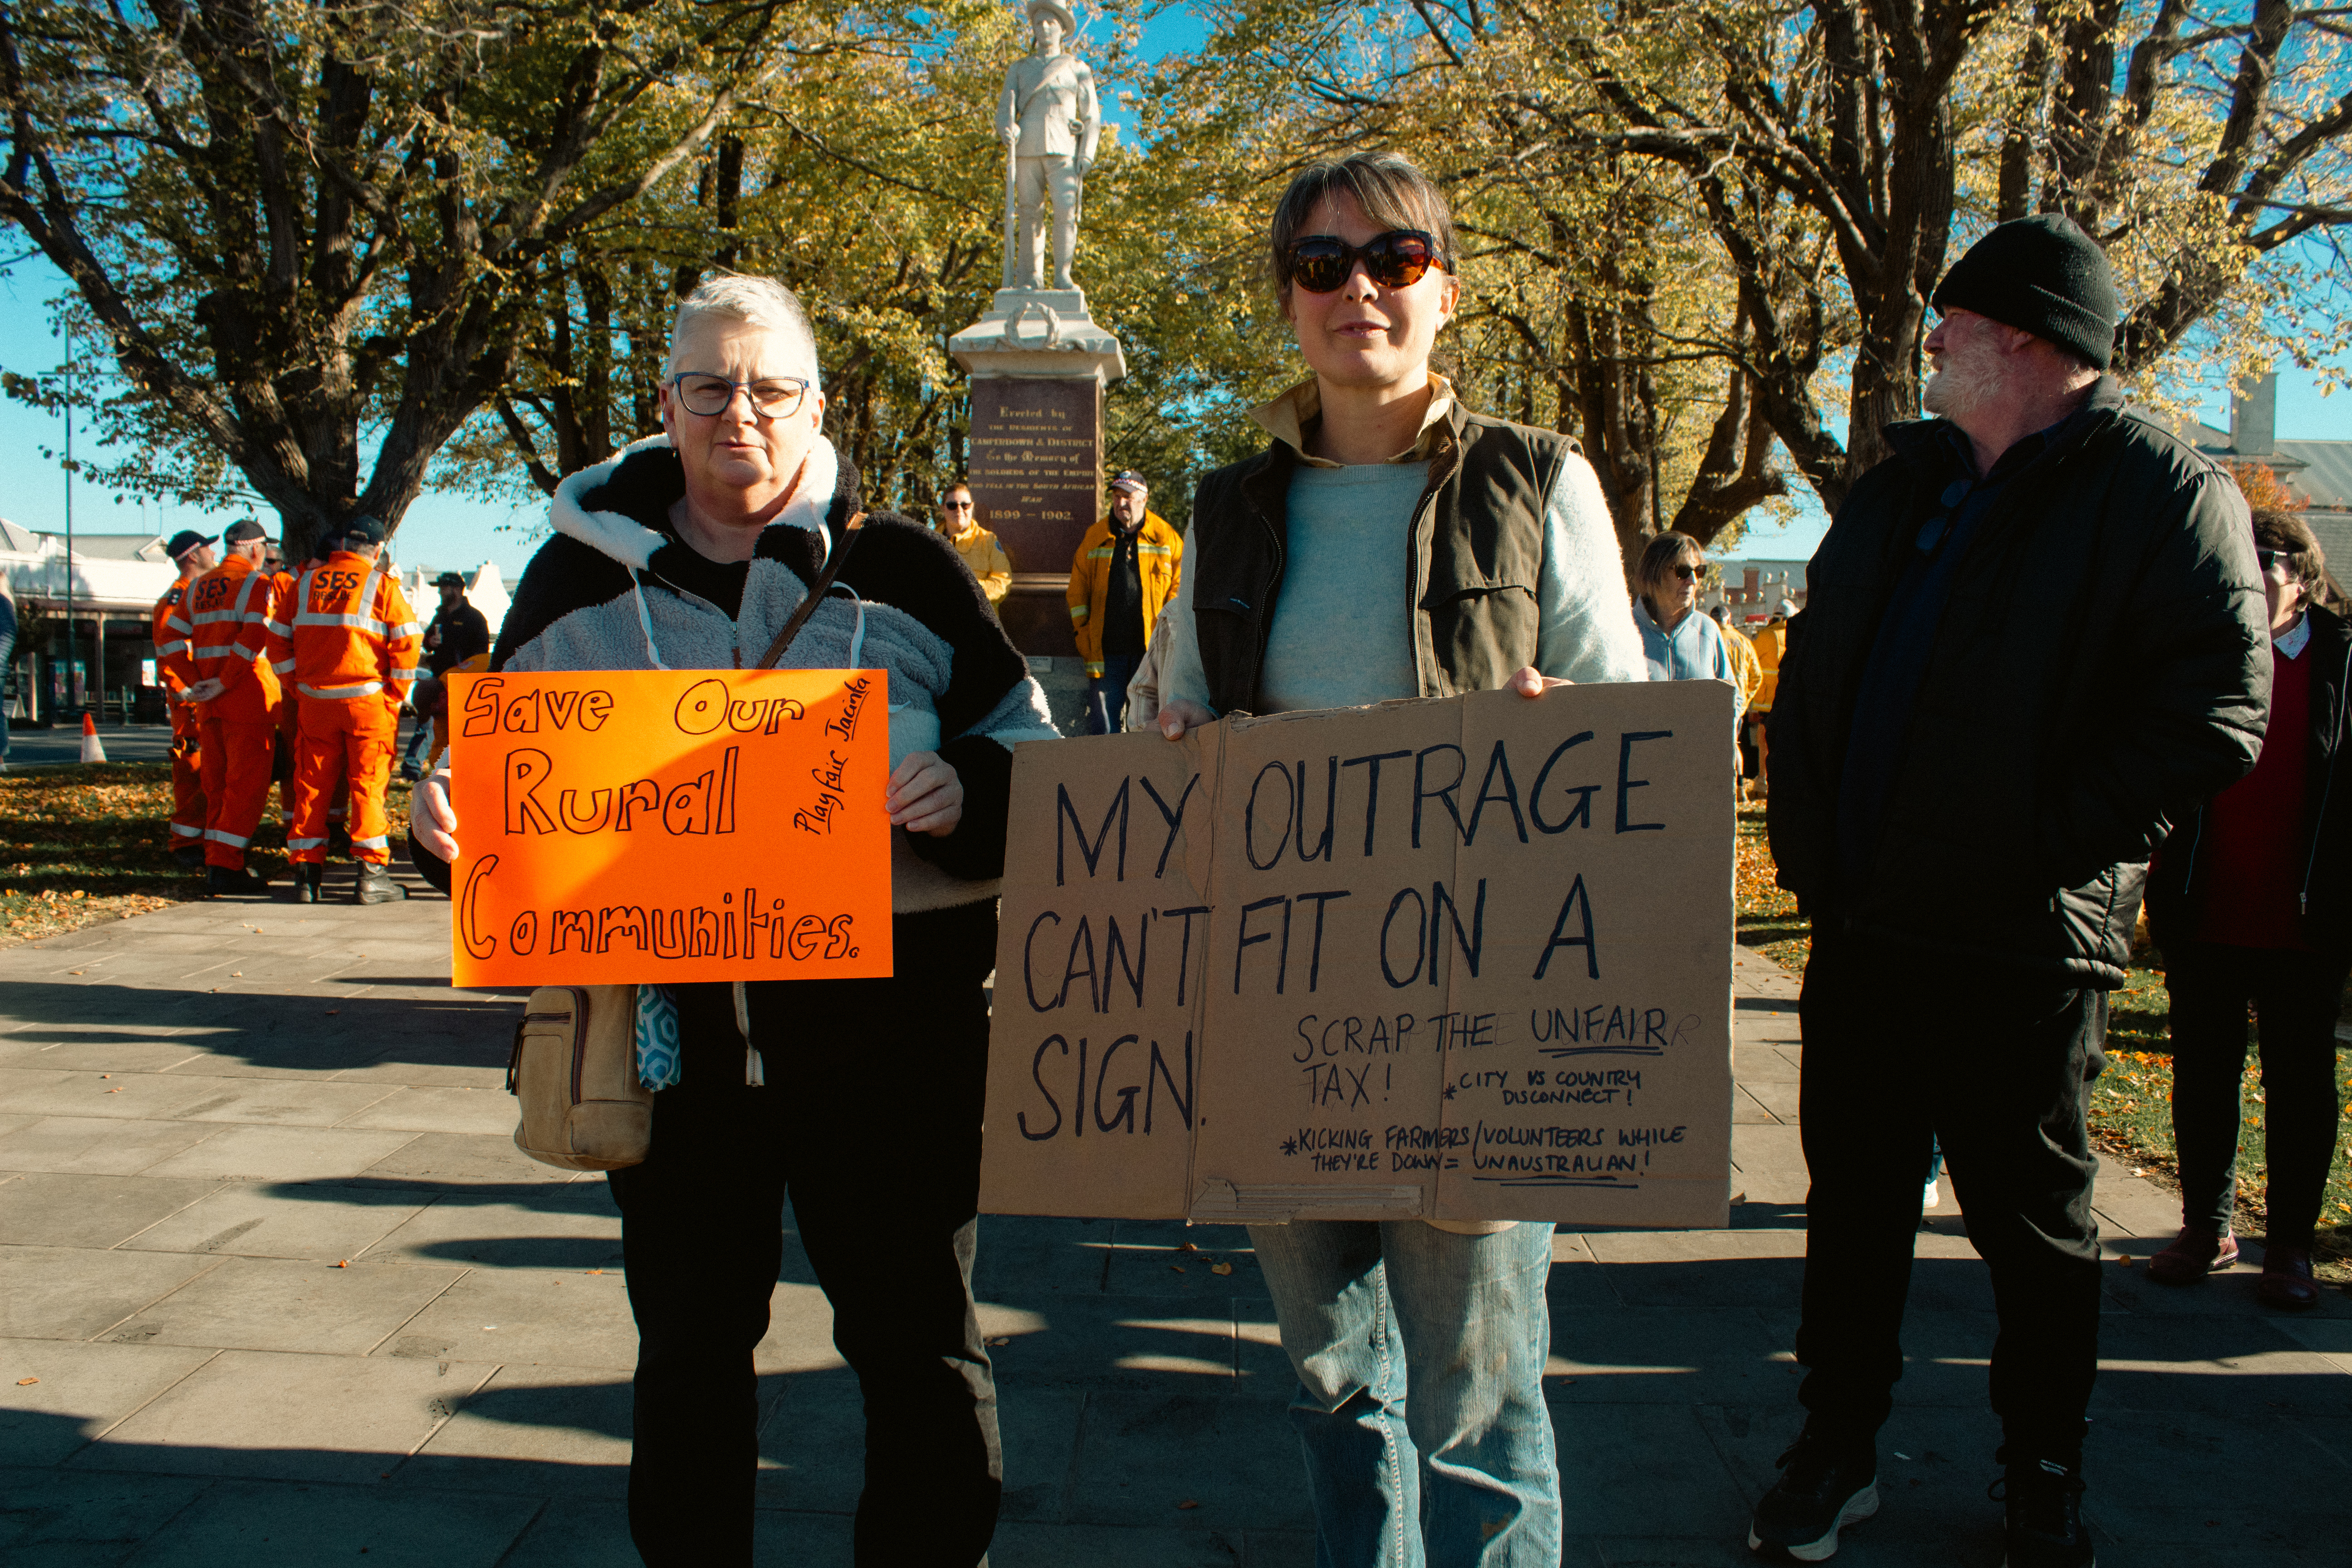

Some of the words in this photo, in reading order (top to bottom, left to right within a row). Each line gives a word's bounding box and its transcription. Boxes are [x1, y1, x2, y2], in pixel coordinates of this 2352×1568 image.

[1000, 406, 1042, 418] Erected
[1051, 408, 1065, 419] by
[1036, 437, 1044, 446] &
[1022, 450, 1066, 463] Memory
[1069, 453, 1080, 465] of
[990, 510, 1021, 520] 1899
[196, 577, 230, 600] SES
[315, 571, 359, 589] SES
[462, 677, 614, 738] Save
[675, 679, 804, 735] Our
[825, 677, 871, 742] Jacinta
[505, 746, 740, 836] Rural
[1055, 772, 1200, 887] MY
[1244, 730, 1673, 871] OUTRAGE
[460, 854, 859, 961] Communities.
[1024, 905, 1216, 1013] CAN'T
[1234, 890, 1351, 995] FIT
[1379, 877, 1487, 989] ON
[1532, 873, 1600, 980] A
[1293, 1013, 1415, 1063] SCRAP
[1427, 1012, 1496, 1053] THE
[1531, 1004, 1668, 1046] UNFAIR
[1017, 1029, 1207, 1142] SIGN.
[1527, 1069, 1546, 1087] VS
[1555, 1070, 1641, 1089] COUNTRY
[1618, 1125, 1687, 1147] WHILE
[1310, 1152, 1379, 1172] THEY'RE
